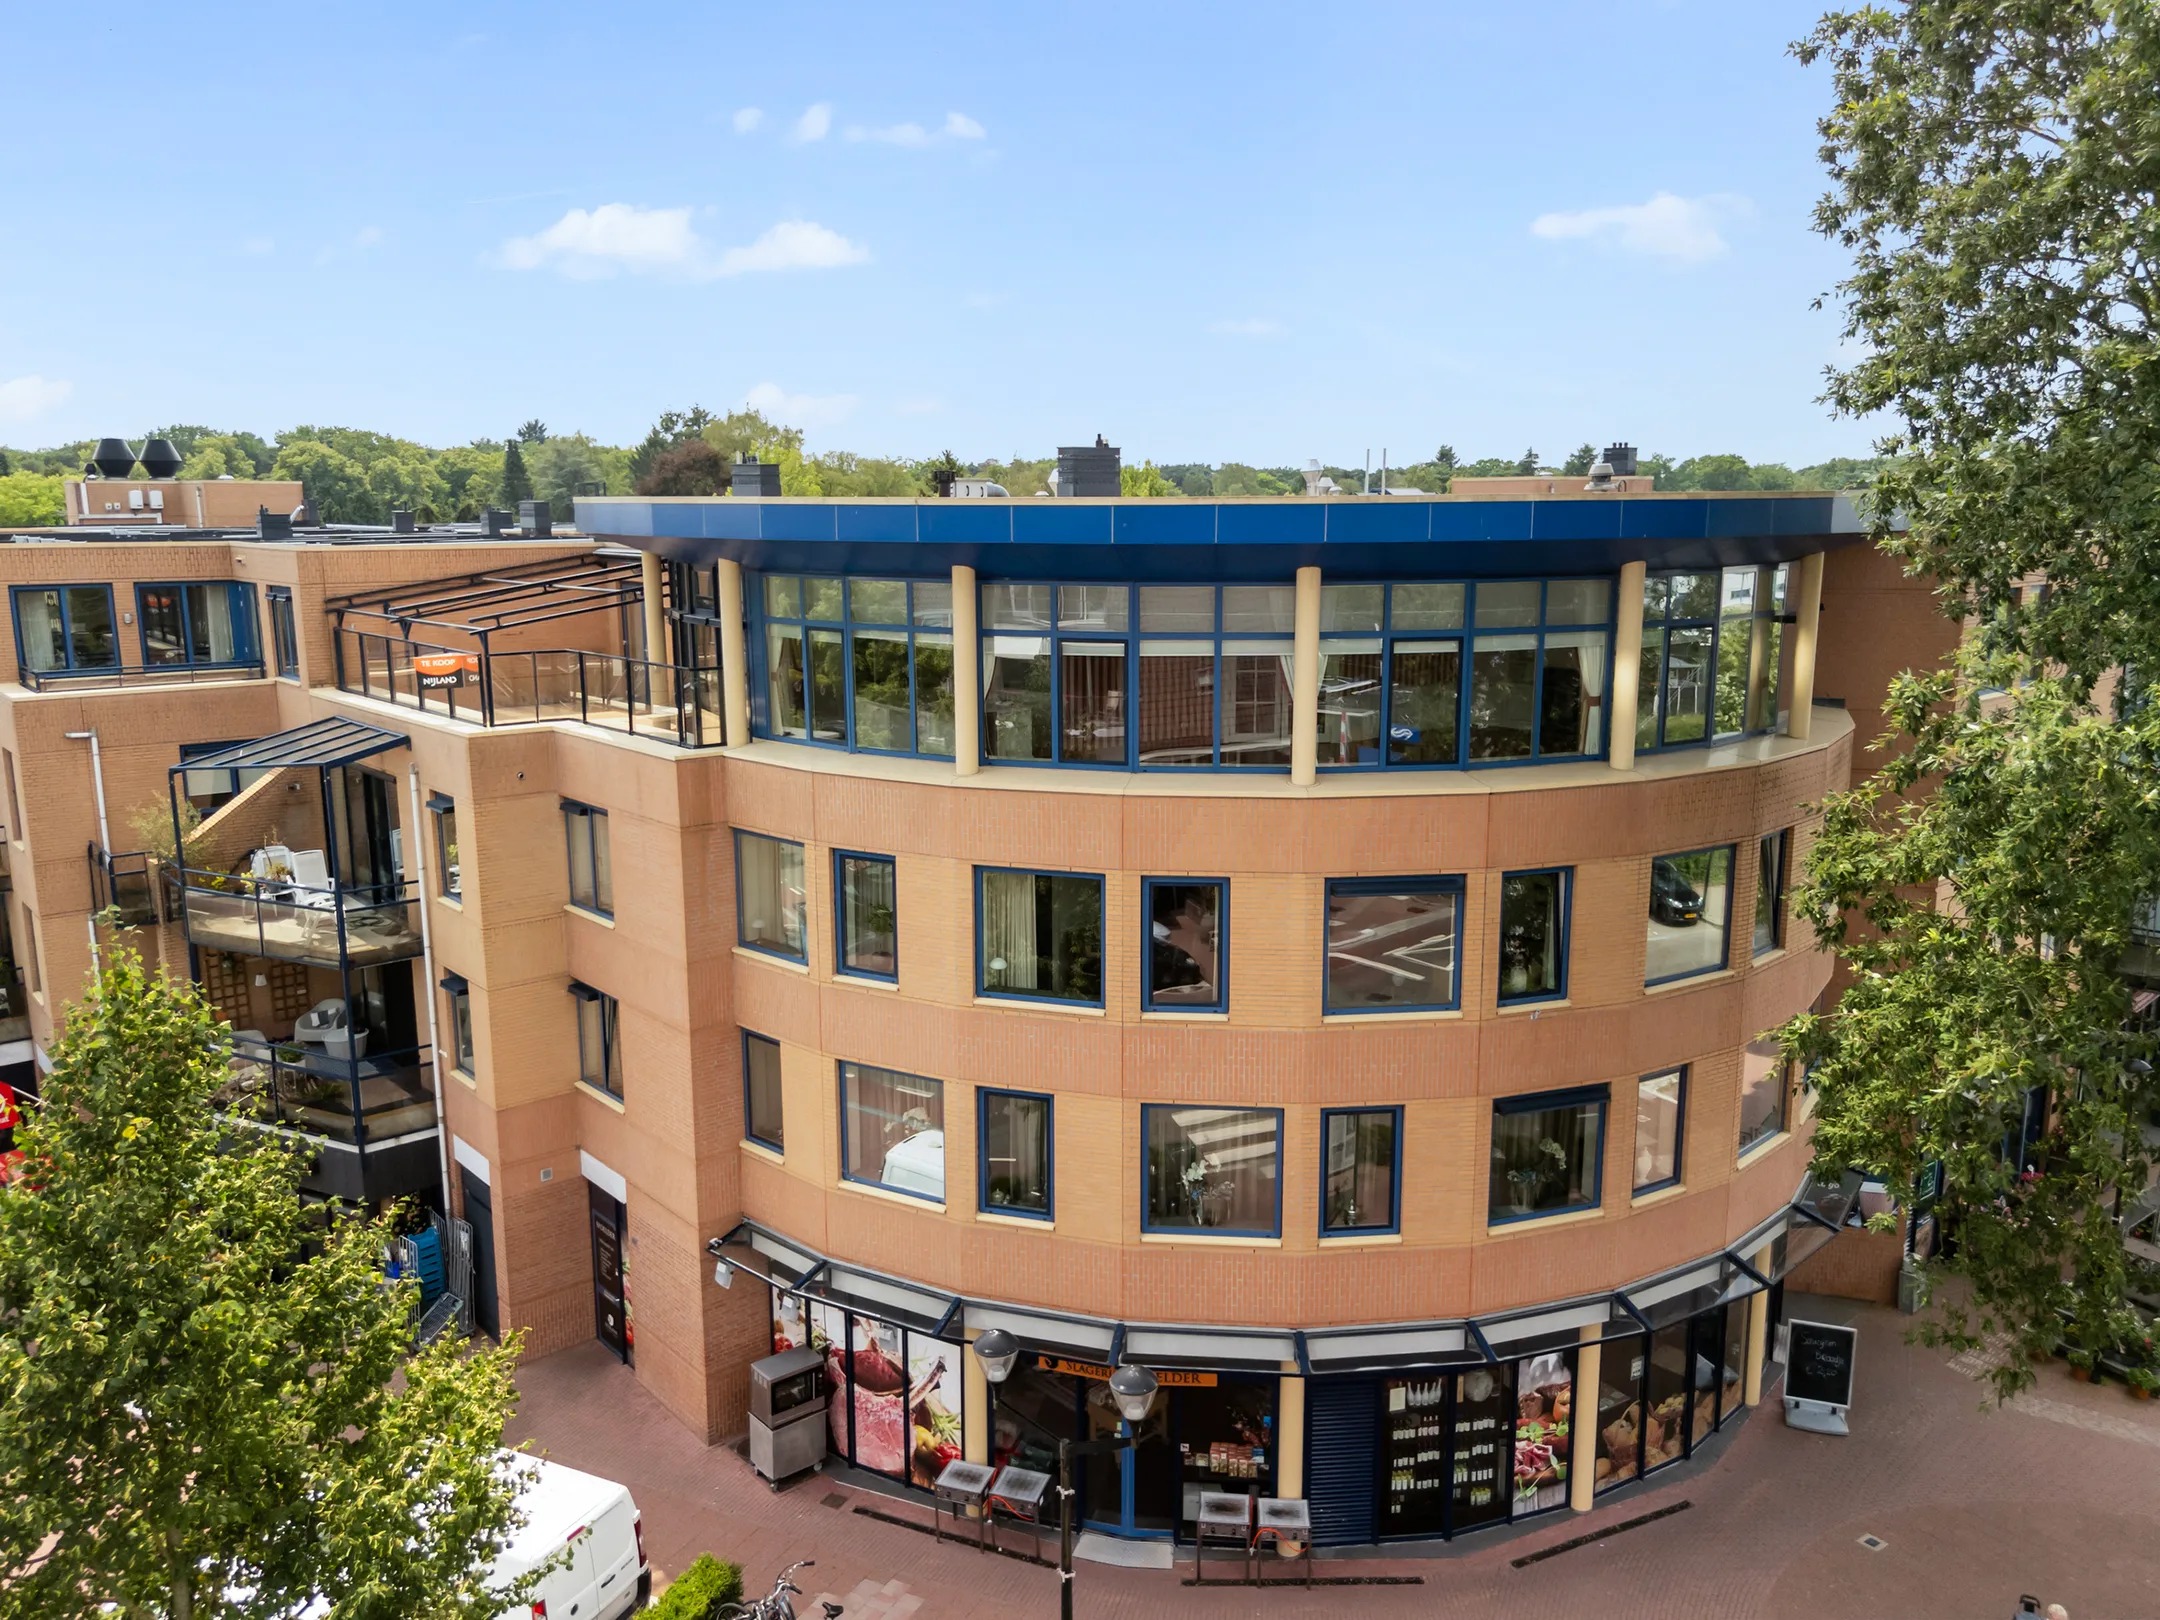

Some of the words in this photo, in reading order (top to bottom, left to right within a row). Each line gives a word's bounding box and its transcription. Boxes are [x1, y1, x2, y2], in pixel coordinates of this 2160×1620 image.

[432, 659, 456, 667] KOOP
[423, 676, 457, 687] NIJLAND
[1066, 1361, 1113, 1378] SLAGERI
